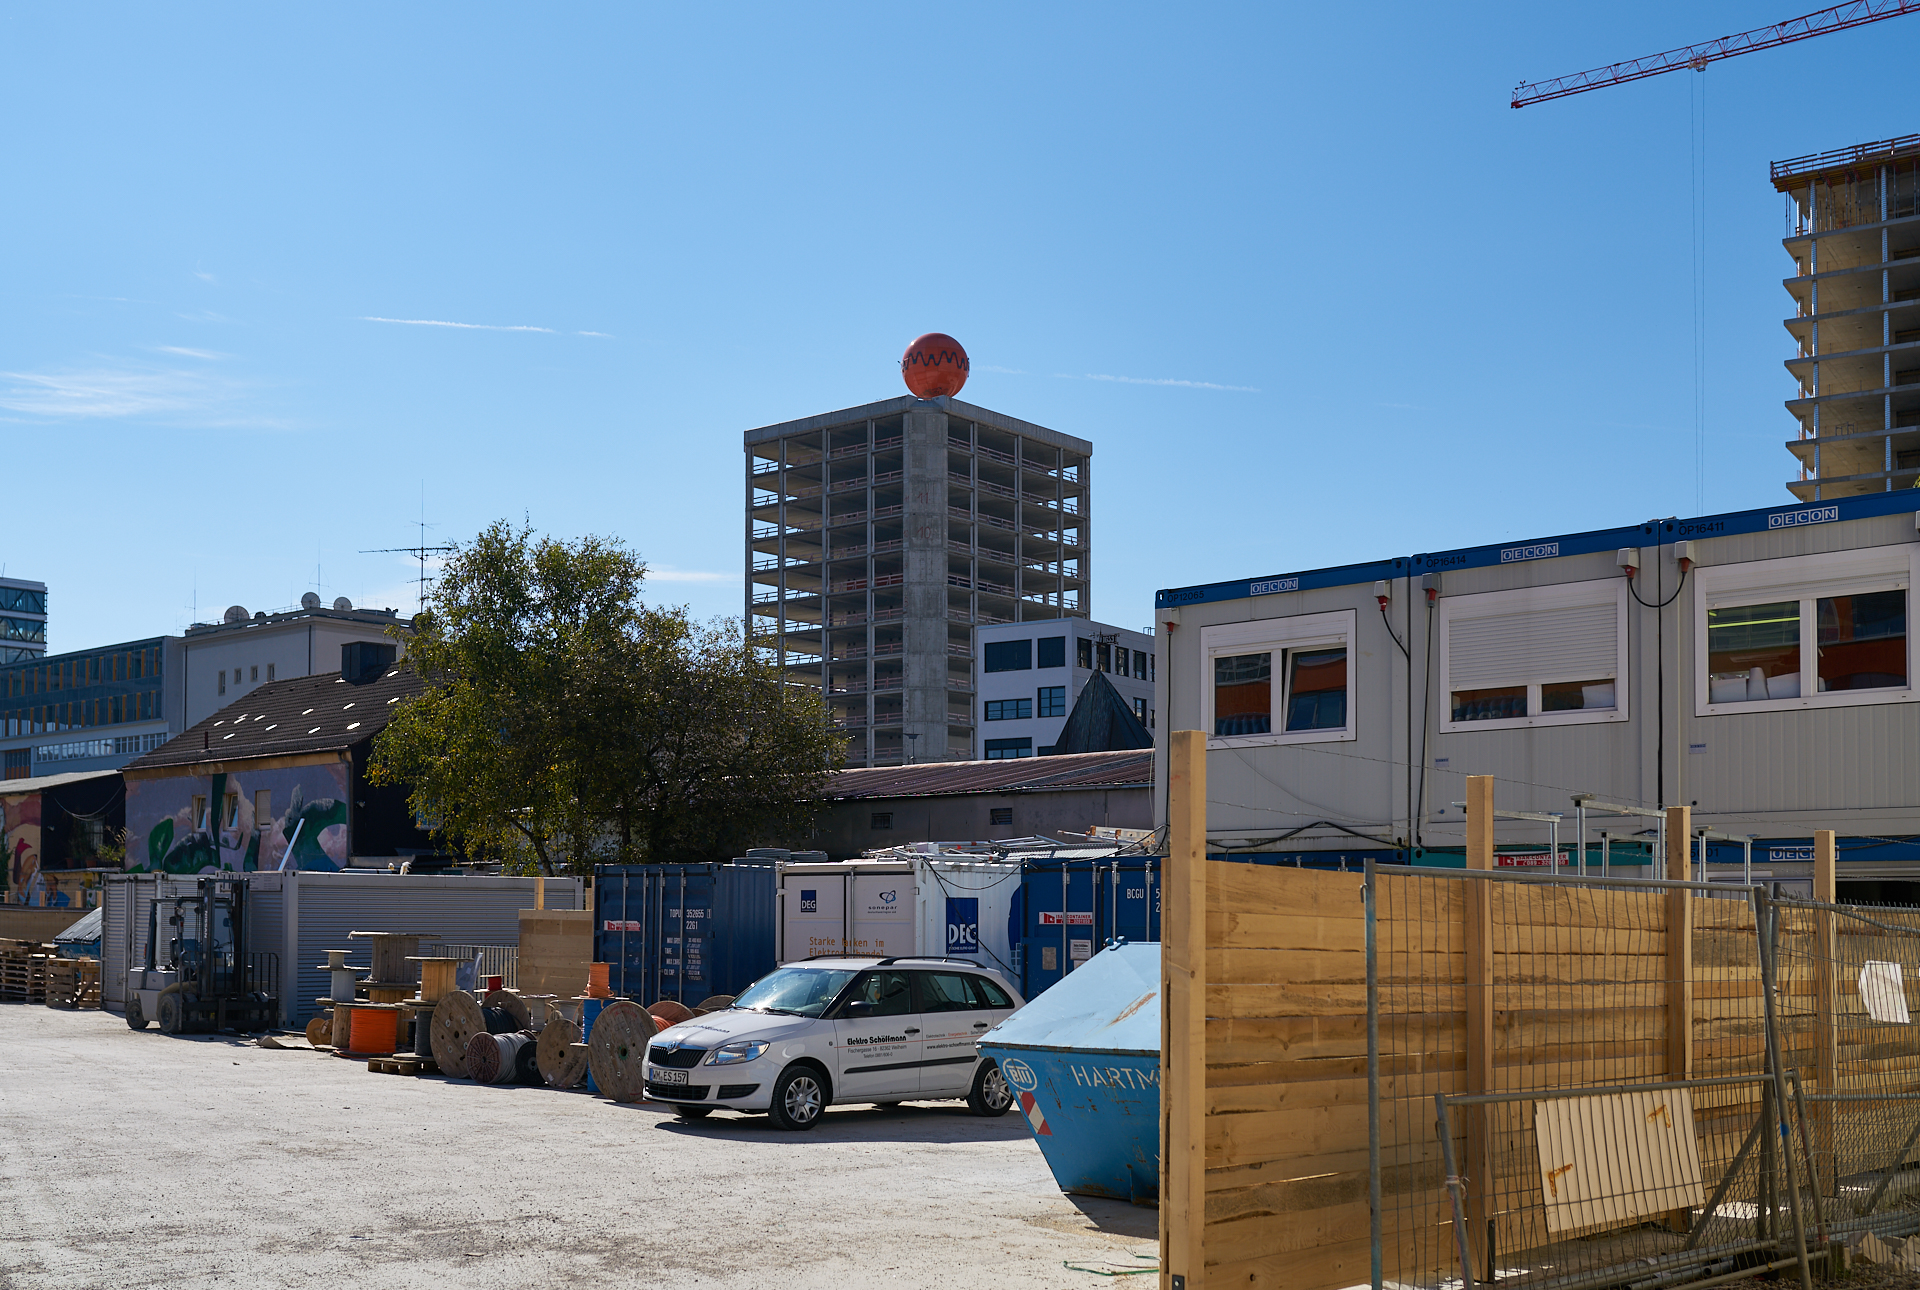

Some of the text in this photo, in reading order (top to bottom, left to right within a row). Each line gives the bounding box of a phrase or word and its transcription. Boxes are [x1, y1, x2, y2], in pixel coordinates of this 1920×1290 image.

[1769, 507, 1839, 528] OECON
[916, 526, 932, 540] 10
[1678, 521, 1725, 536] OP16411
[1501, 544, 1558, 562] OECON
[1425, 555, 1466, 568] OP16414
[1251, 579, 1298, 595] OECON
[1167, 590, 1205, 603] OP12065
[1126, 888, 1145, 899] BCGU
[802, 900, 816, 909] DEG
[948, 923, 977, 944] DEG
[809, 936, 836, 946] Starke
[874, 938, 885, 947] im
[847, 1034, 907, 1046] Elektro Schöffmann
[663, 1071, 673, 1082] ES
[673, 1073, 687, 1083] 157
